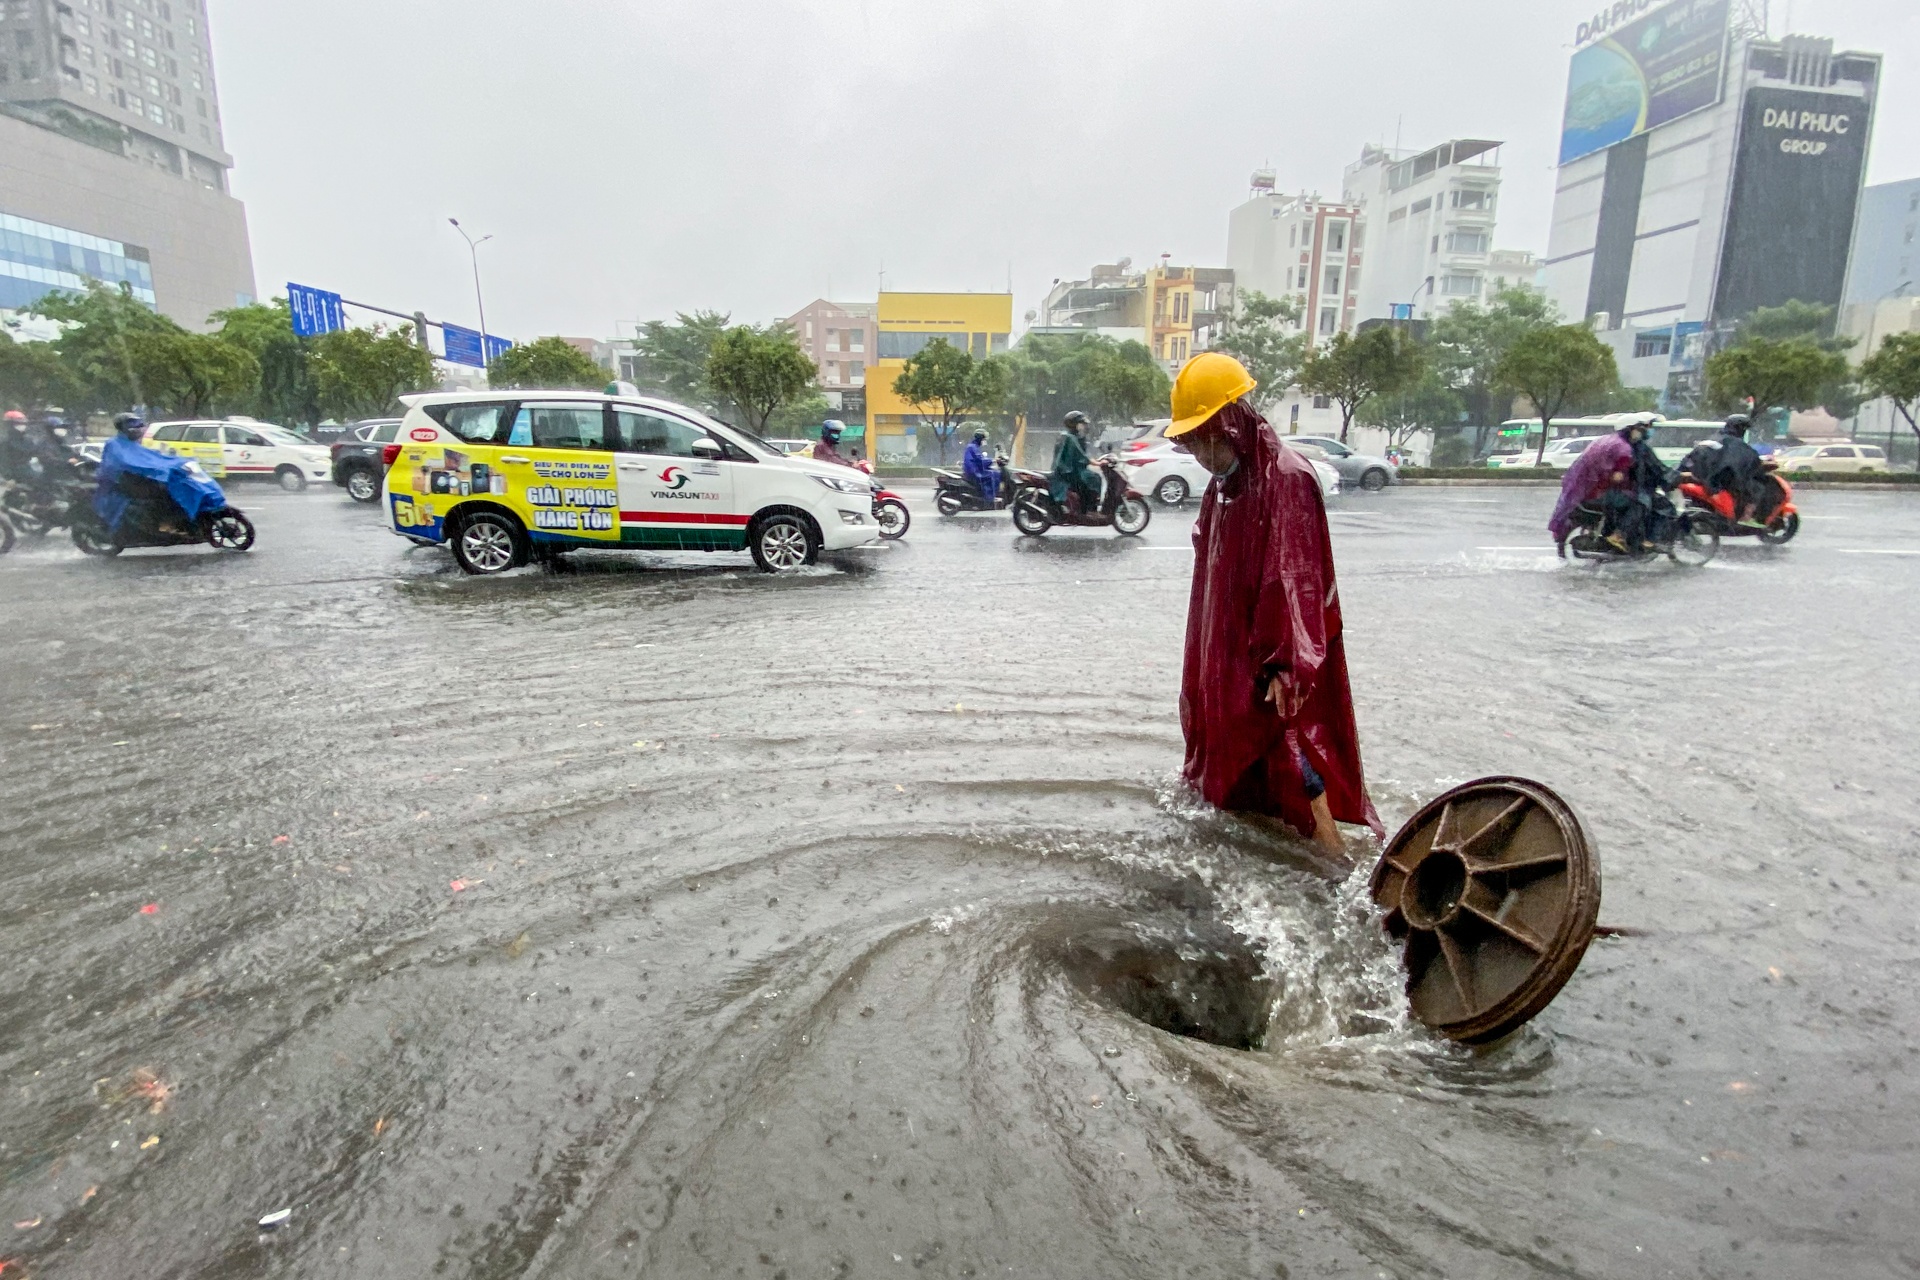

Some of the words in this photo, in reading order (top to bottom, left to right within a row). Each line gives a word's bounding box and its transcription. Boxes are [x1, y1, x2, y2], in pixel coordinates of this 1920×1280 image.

[1575, 8, 1609, 46] DAI
[1610, 0, 1655, 26] PHU
[1763, 108, 1797, 129] DAI
[1799, 111, 1849, 134] PHUC
[1780, 138, 1827, 155] GROUP
